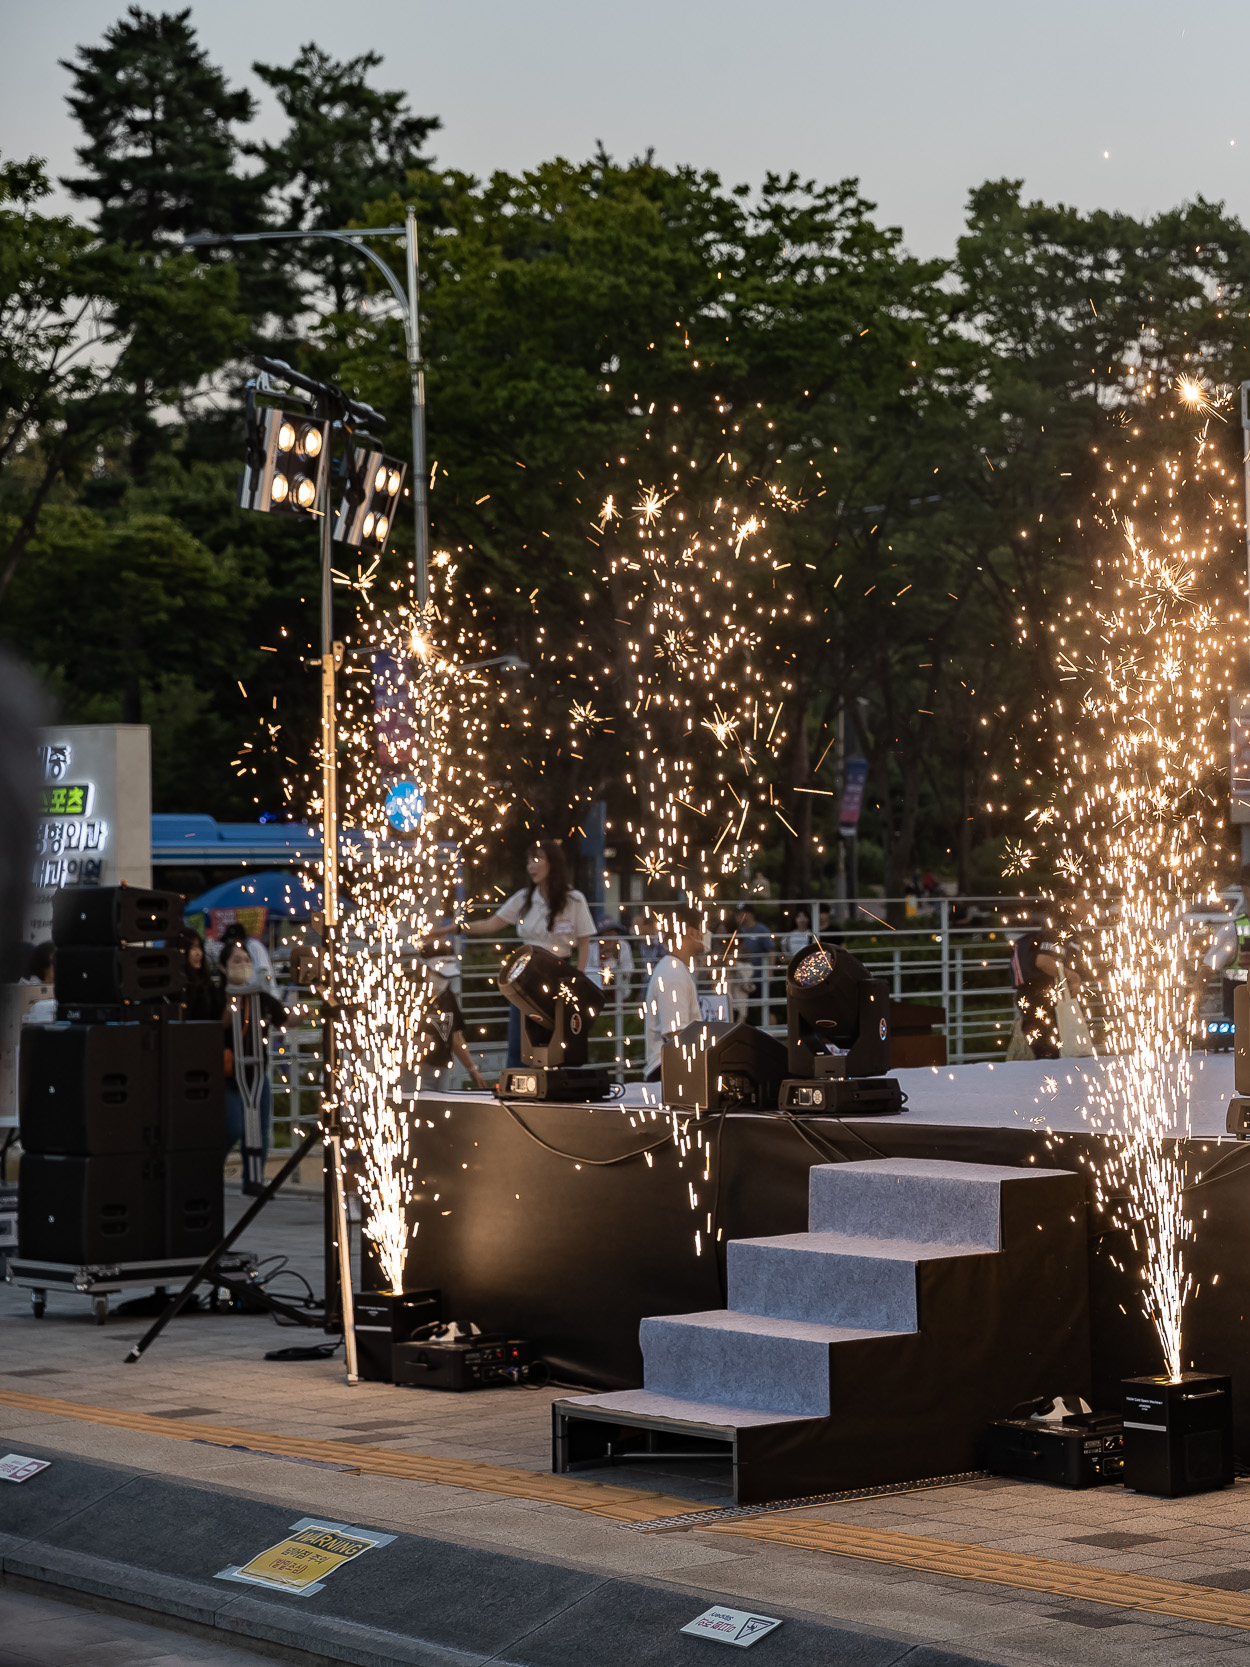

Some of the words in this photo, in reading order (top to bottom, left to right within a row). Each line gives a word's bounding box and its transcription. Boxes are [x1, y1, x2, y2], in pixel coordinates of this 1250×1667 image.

[296, 1531, 363, 1555] WARNING
[281, 1546, 313, 1560] 넘어짐
[308, 1553, 330, 1565] 주의
